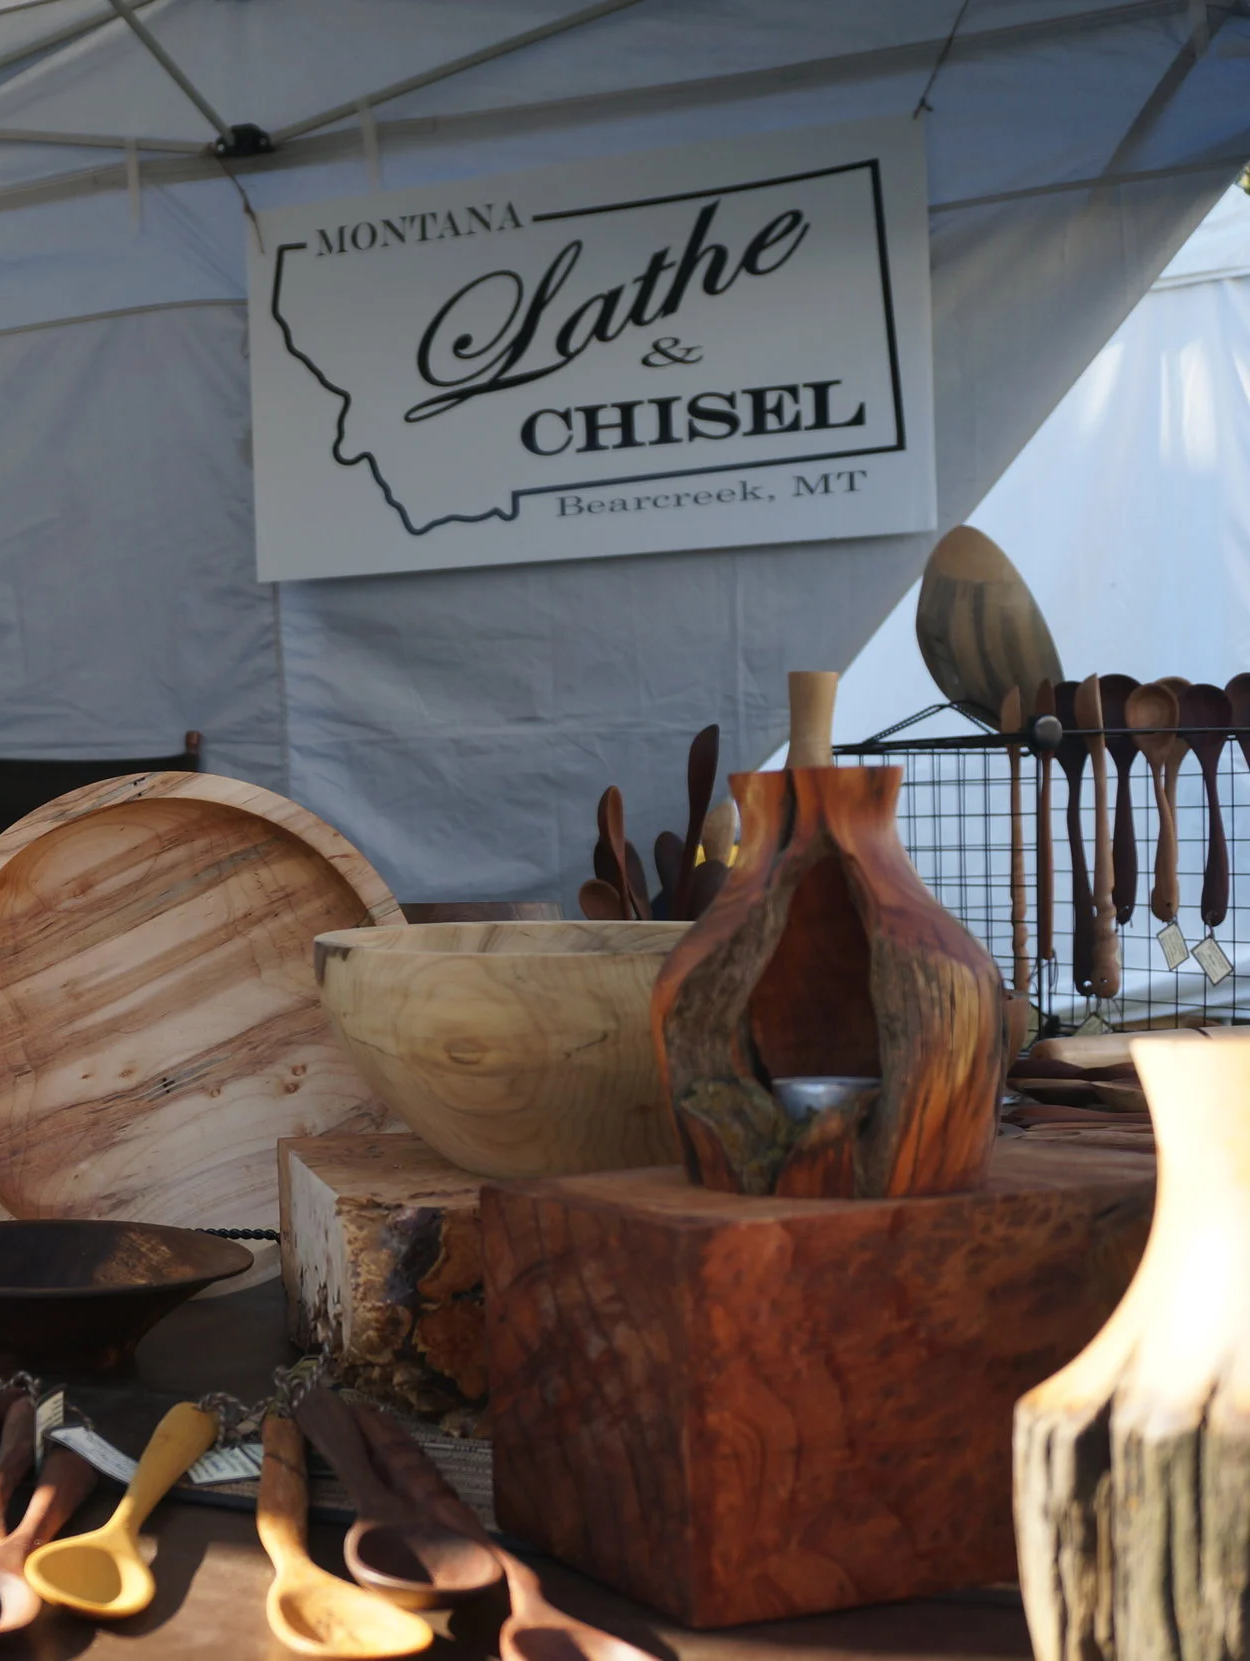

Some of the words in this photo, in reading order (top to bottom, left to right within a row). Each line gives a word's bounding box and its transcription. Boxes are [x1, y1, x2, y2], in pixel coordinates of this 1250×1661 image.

[315, 201, 524, 256] MONTANA
[404, 199, 811, 423] Lathe
[641, 336, 703, 368] &
[520, 379, 866, 456] CHISEL
[556, 480, 776, 518] Bearcreek,
[792, 470, 868, 498] MT
